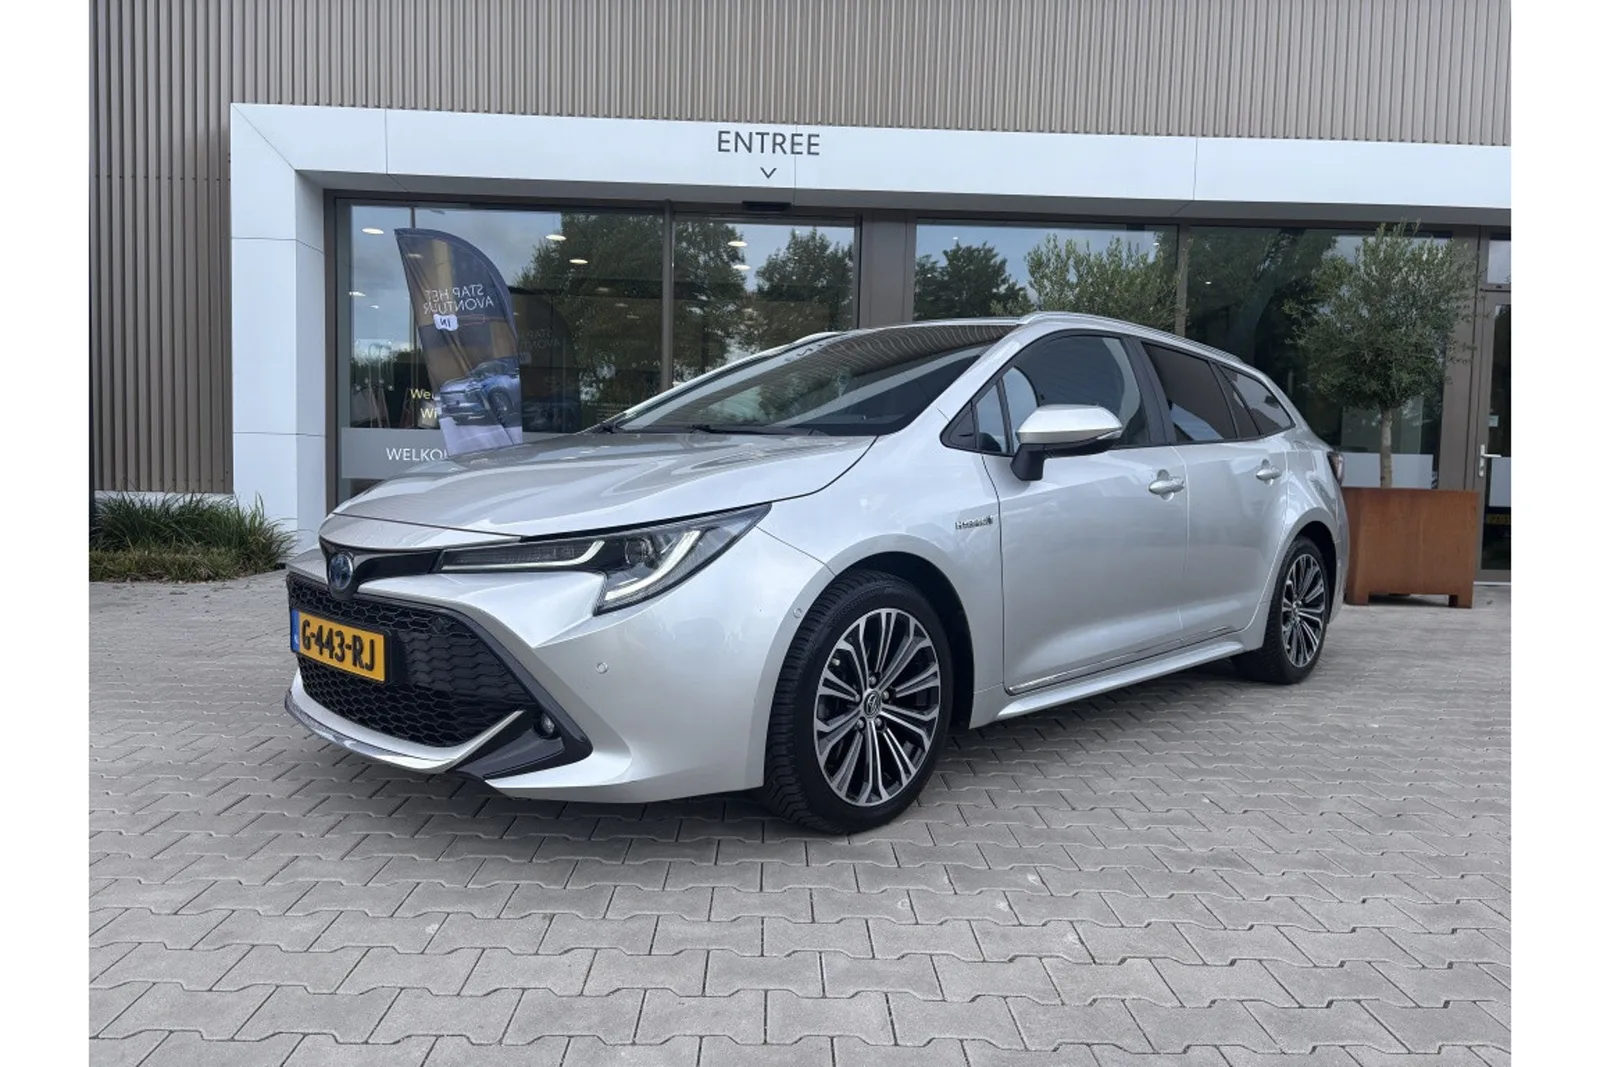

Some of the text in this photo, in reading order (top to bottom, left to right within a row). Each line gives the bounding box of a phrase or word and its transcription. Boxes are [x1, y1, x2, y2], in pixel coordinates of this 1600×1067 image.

[717, 130, 820, 156] ENTREE
[385, 447, 447, 462] WELKO
[301, 619, 375, 672] G-443-RJ
